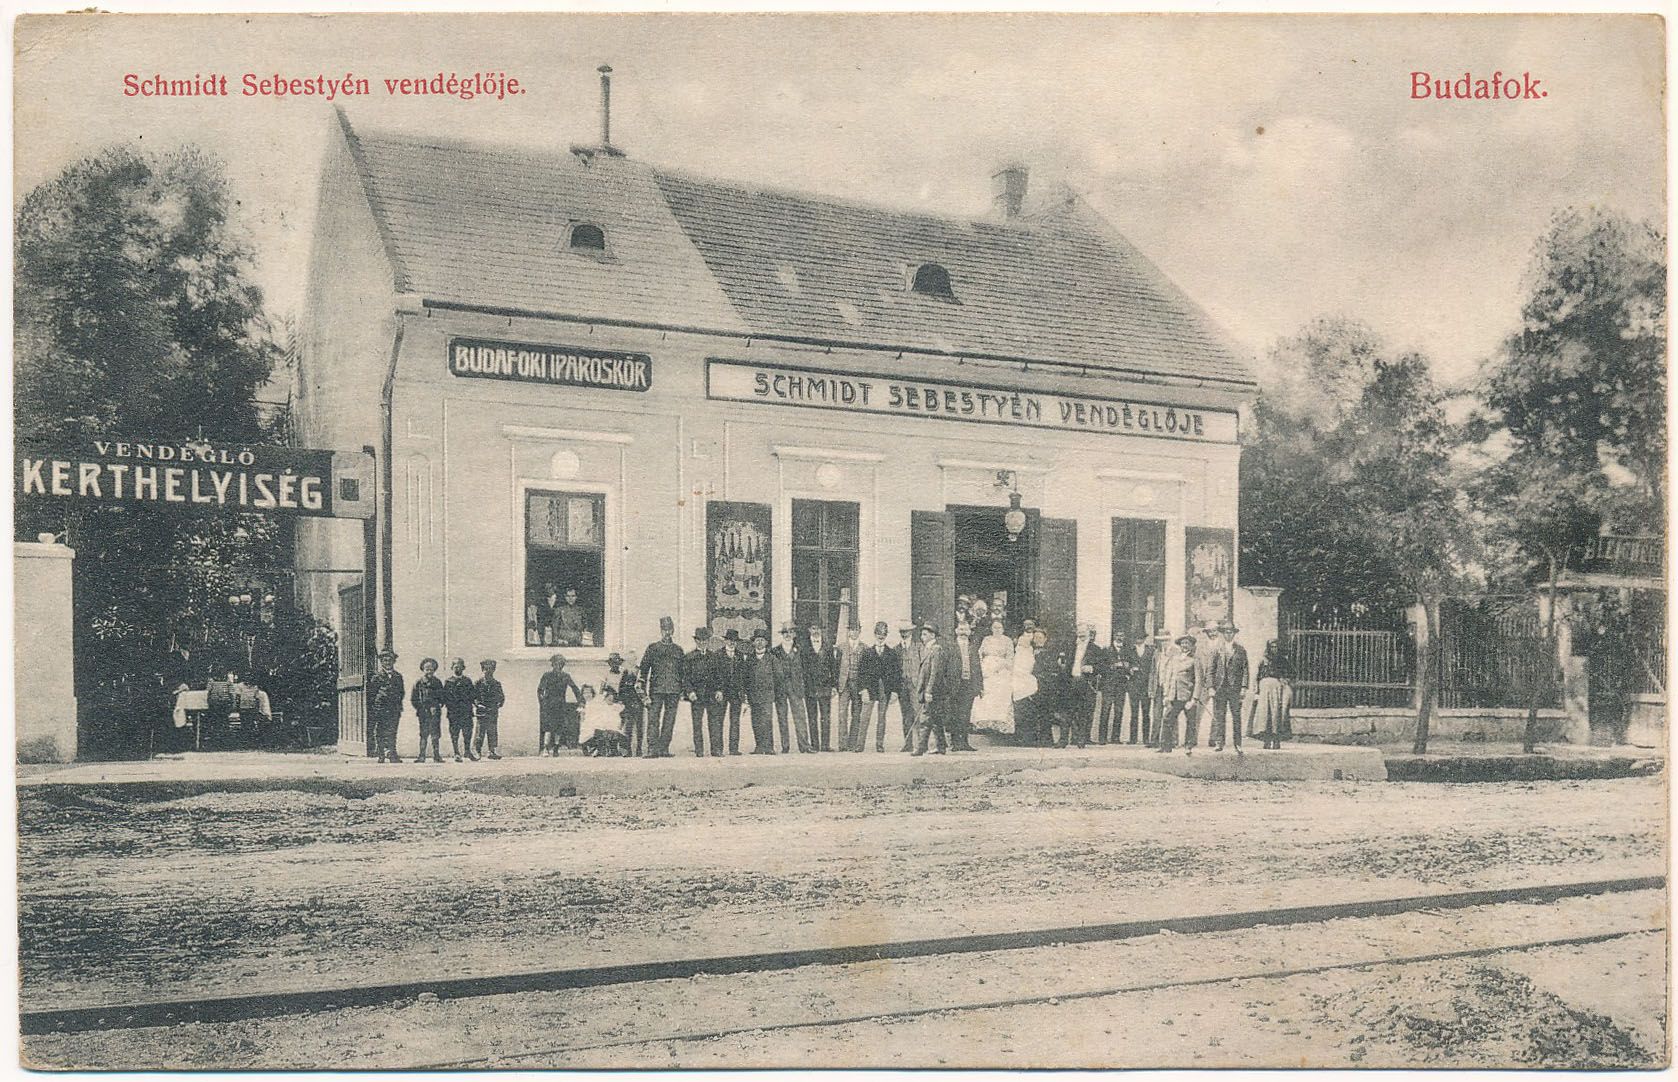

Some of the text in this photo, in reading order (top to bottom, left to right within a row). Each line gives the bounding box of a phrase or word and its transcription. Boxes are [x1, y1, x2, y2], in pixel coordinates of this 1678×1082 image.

[455, 345, 648, 388] BUDAFOKI IPAROSKÖR
[754, 372, 874, 406] SCHMIDT
[888, 385, 1042, 420] SEBESTYÉN
[22, 458, 323, 510] KERTHELYISÉG
